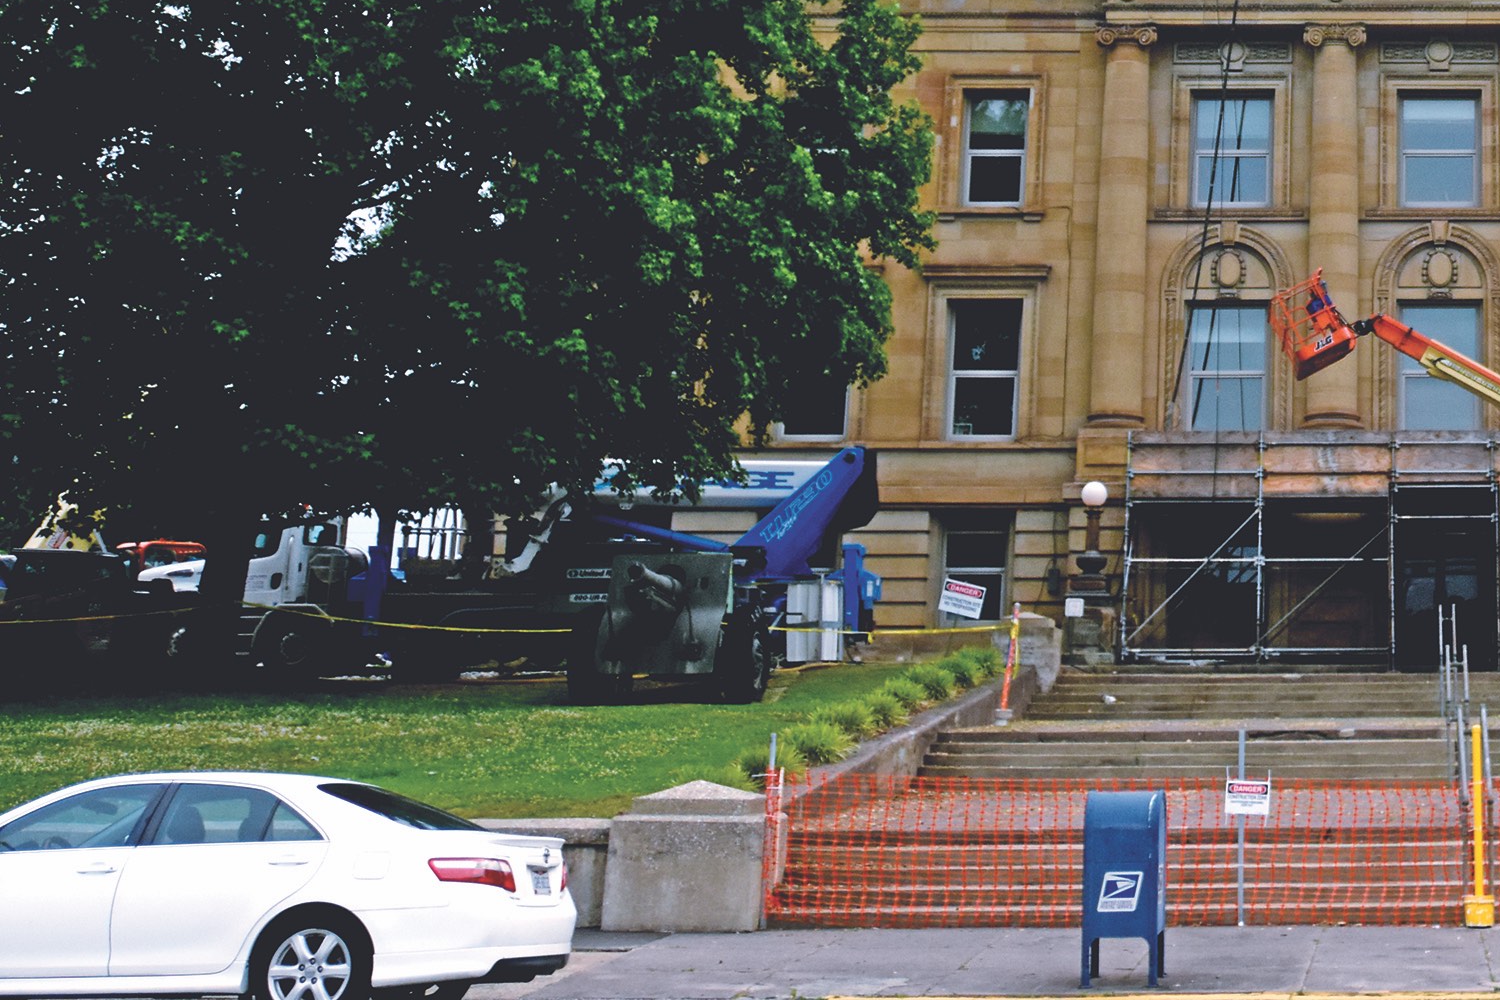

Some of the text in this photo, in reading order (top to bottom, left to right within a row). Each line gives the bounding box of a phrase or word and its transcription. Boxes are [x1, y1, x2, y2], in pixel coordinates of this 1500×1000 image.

[1315, 335, 1333, 351] JLG
[950, 584, 977, 596] DANGER
[1233, 784, 1263, 793] DANGER
